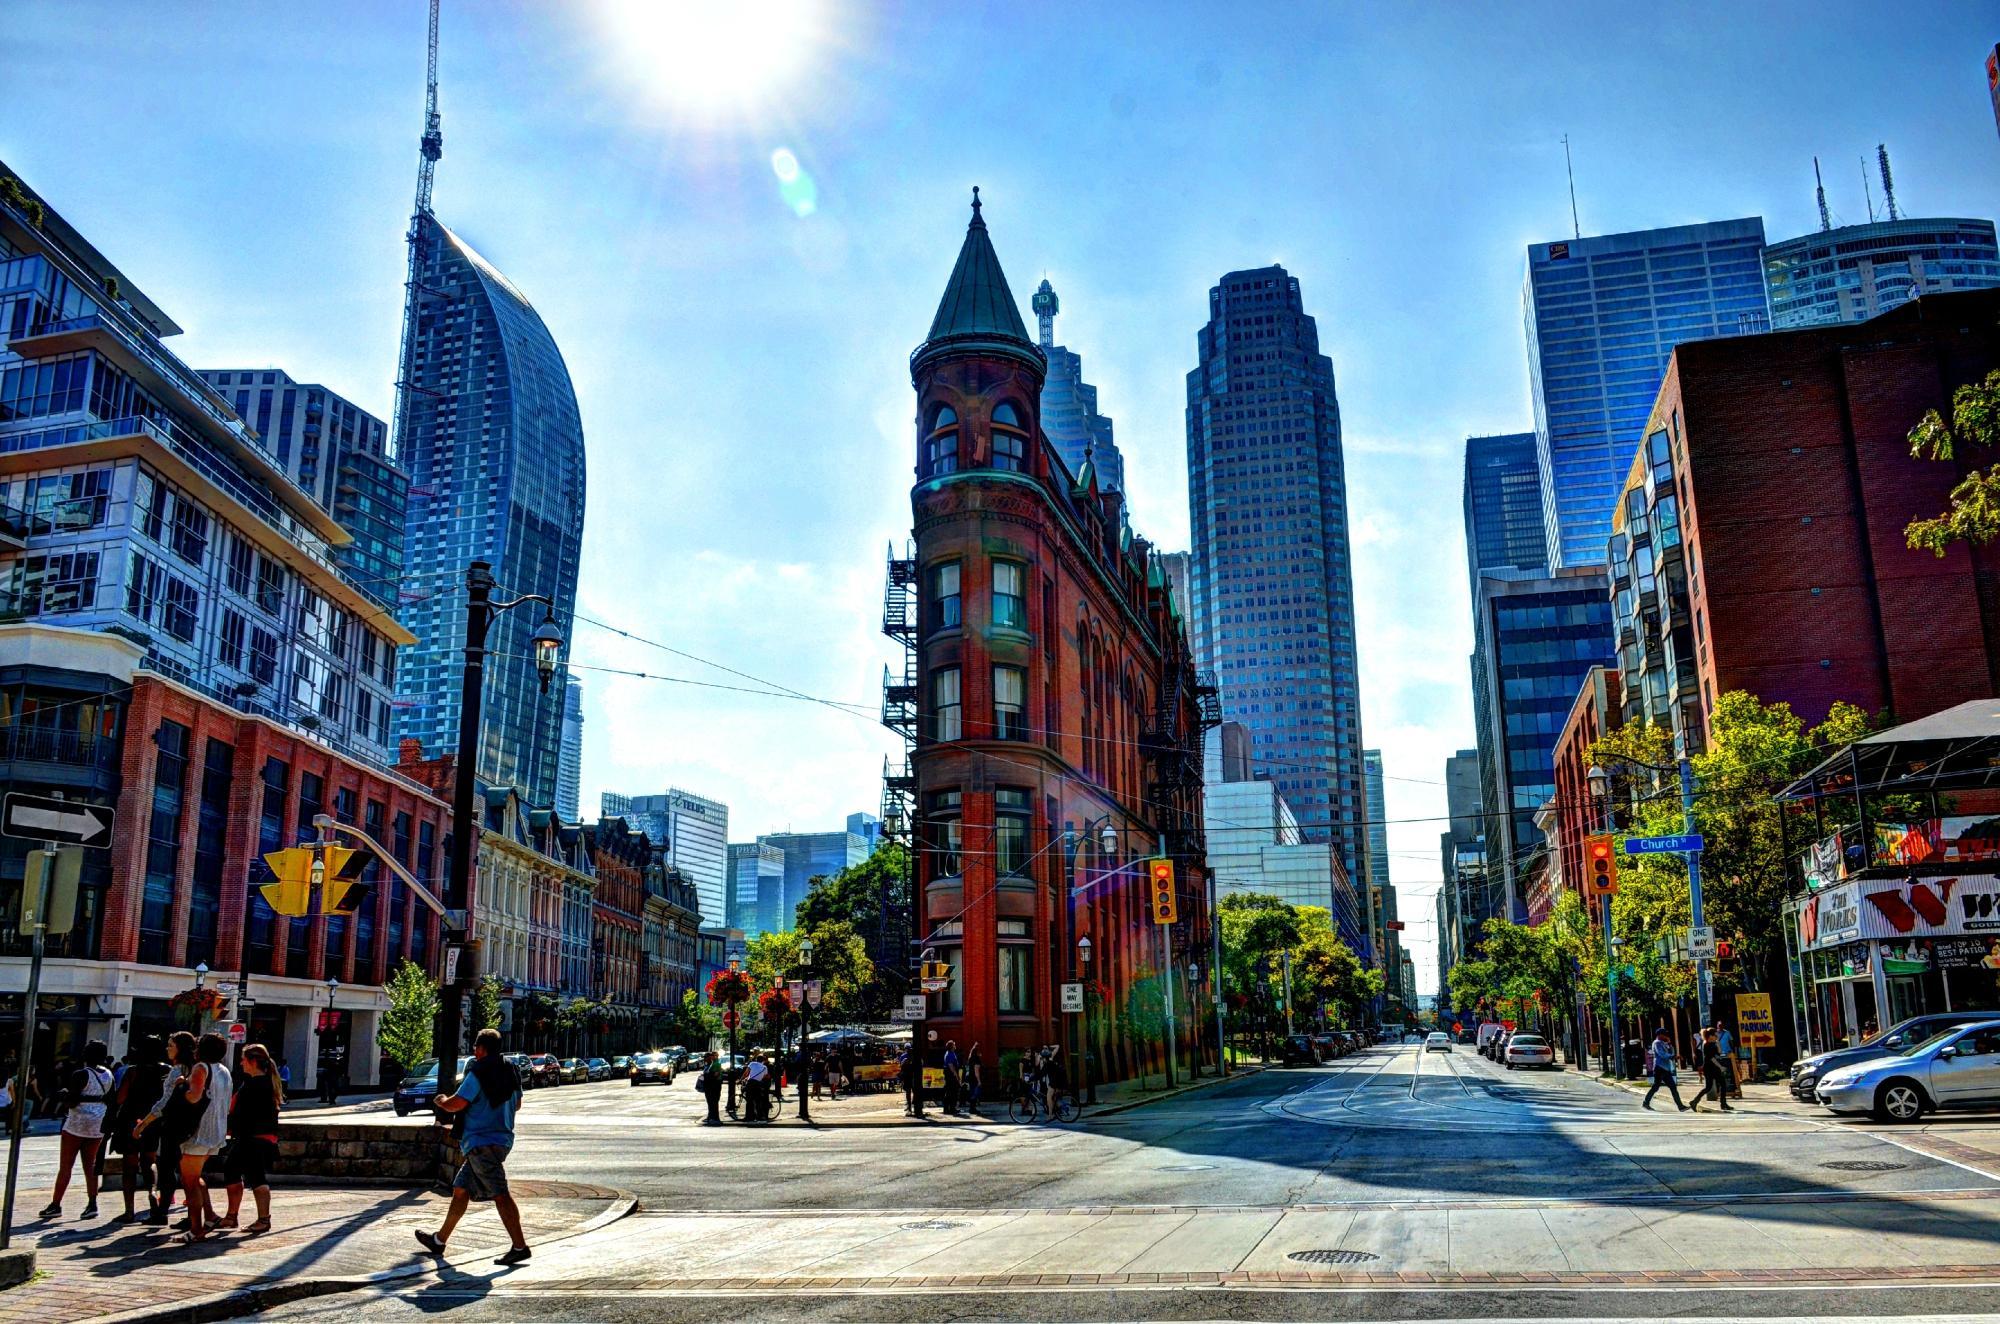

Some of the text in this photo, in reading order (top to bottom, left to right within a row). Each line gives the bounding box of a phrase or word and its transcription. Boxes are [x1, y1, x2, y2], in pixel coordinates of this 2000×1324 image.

[1036, 295, 1049, 303] TD
[683, 799, 705, 814] TELUS
[1640, 838, 1679, 849] Church
[1864, 878, 1958, 933] W
[1821, 906, 1857, 934] WORKS
[1692, 928, 1707, 936] ONE
[1689, 948, 1715, 957] BEGINS
[1938, 949, 1957, 957] BEST
[1066, 985, 1077, 993] ONE
[1741, 1009, 1769, 1020] PUBLIC
[1741, 1022, 1773, 1032] PARKING
